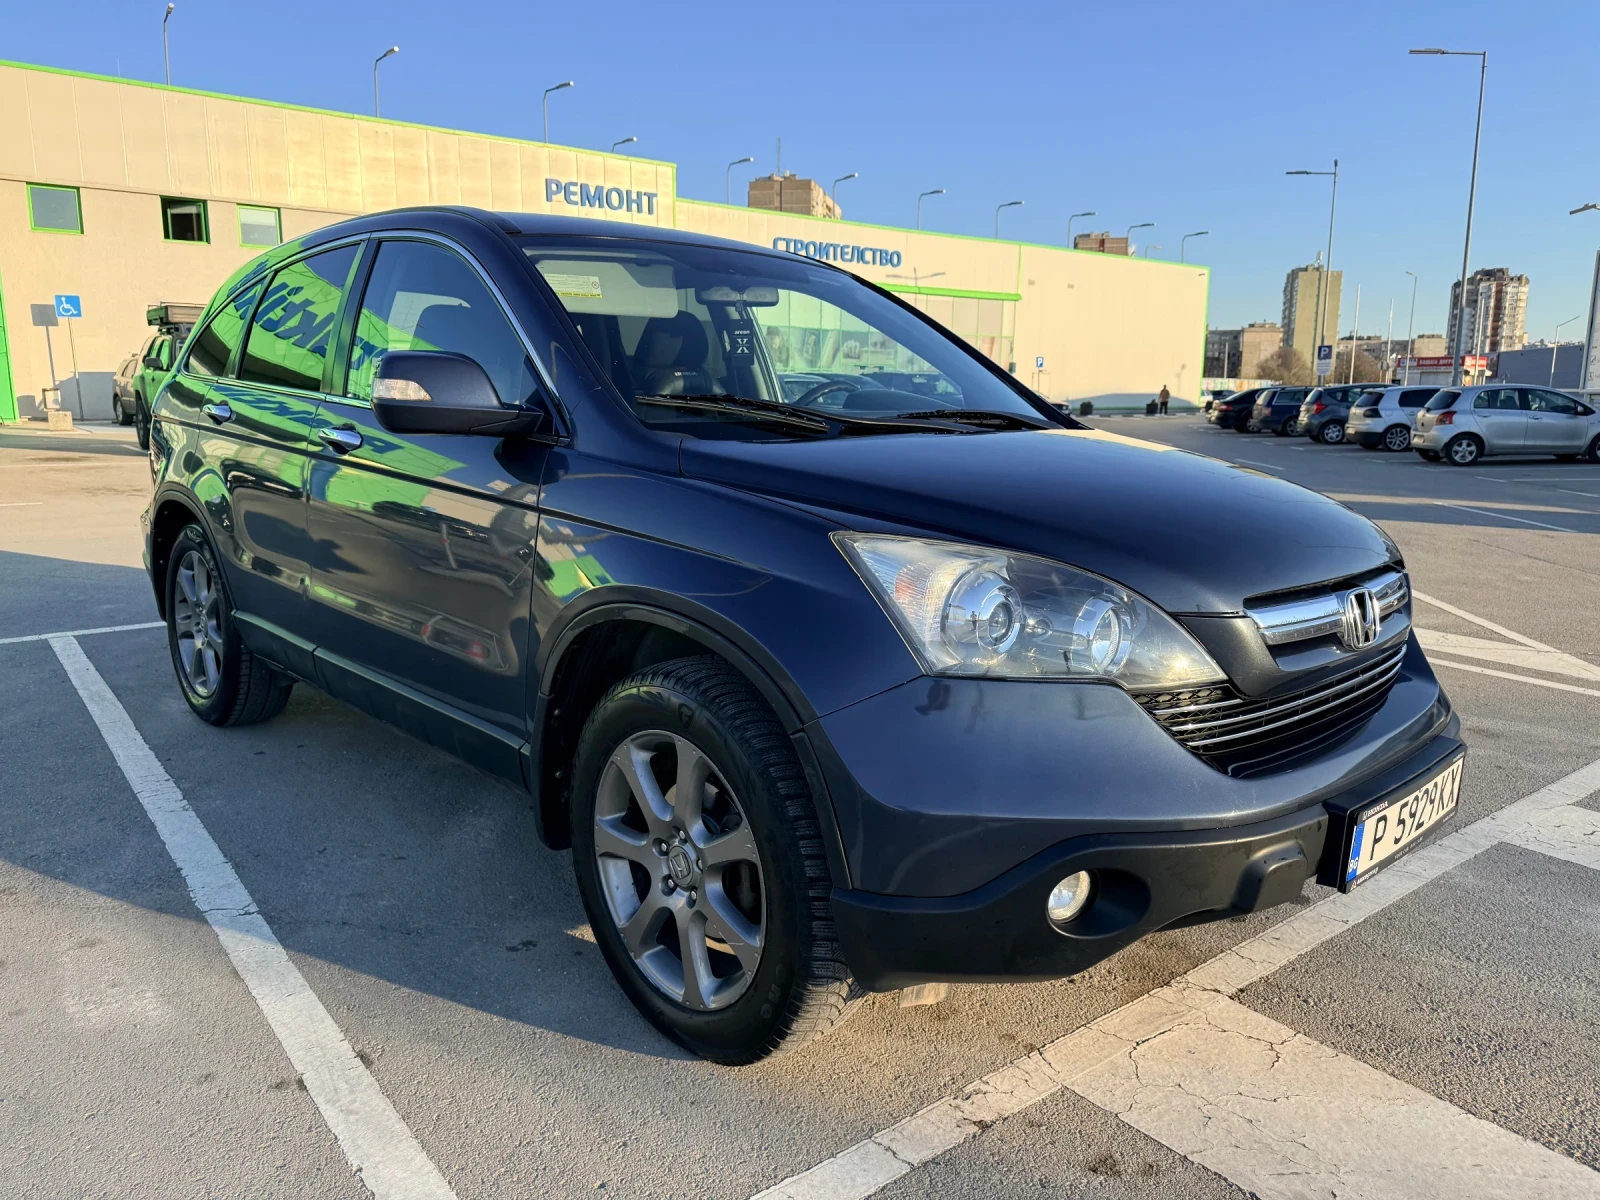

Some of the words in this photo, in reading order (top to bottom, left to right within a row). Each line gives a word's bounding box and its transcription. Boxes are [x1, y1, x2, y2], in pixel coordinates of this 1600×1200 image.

[545, 178, 657, 215] РЕМОНТ
[773, 237, 902, 268] СТРОИТЕЛСТВО
[1320, 347, 1329, 358] P
[1369, 813, 1388, 861] P
